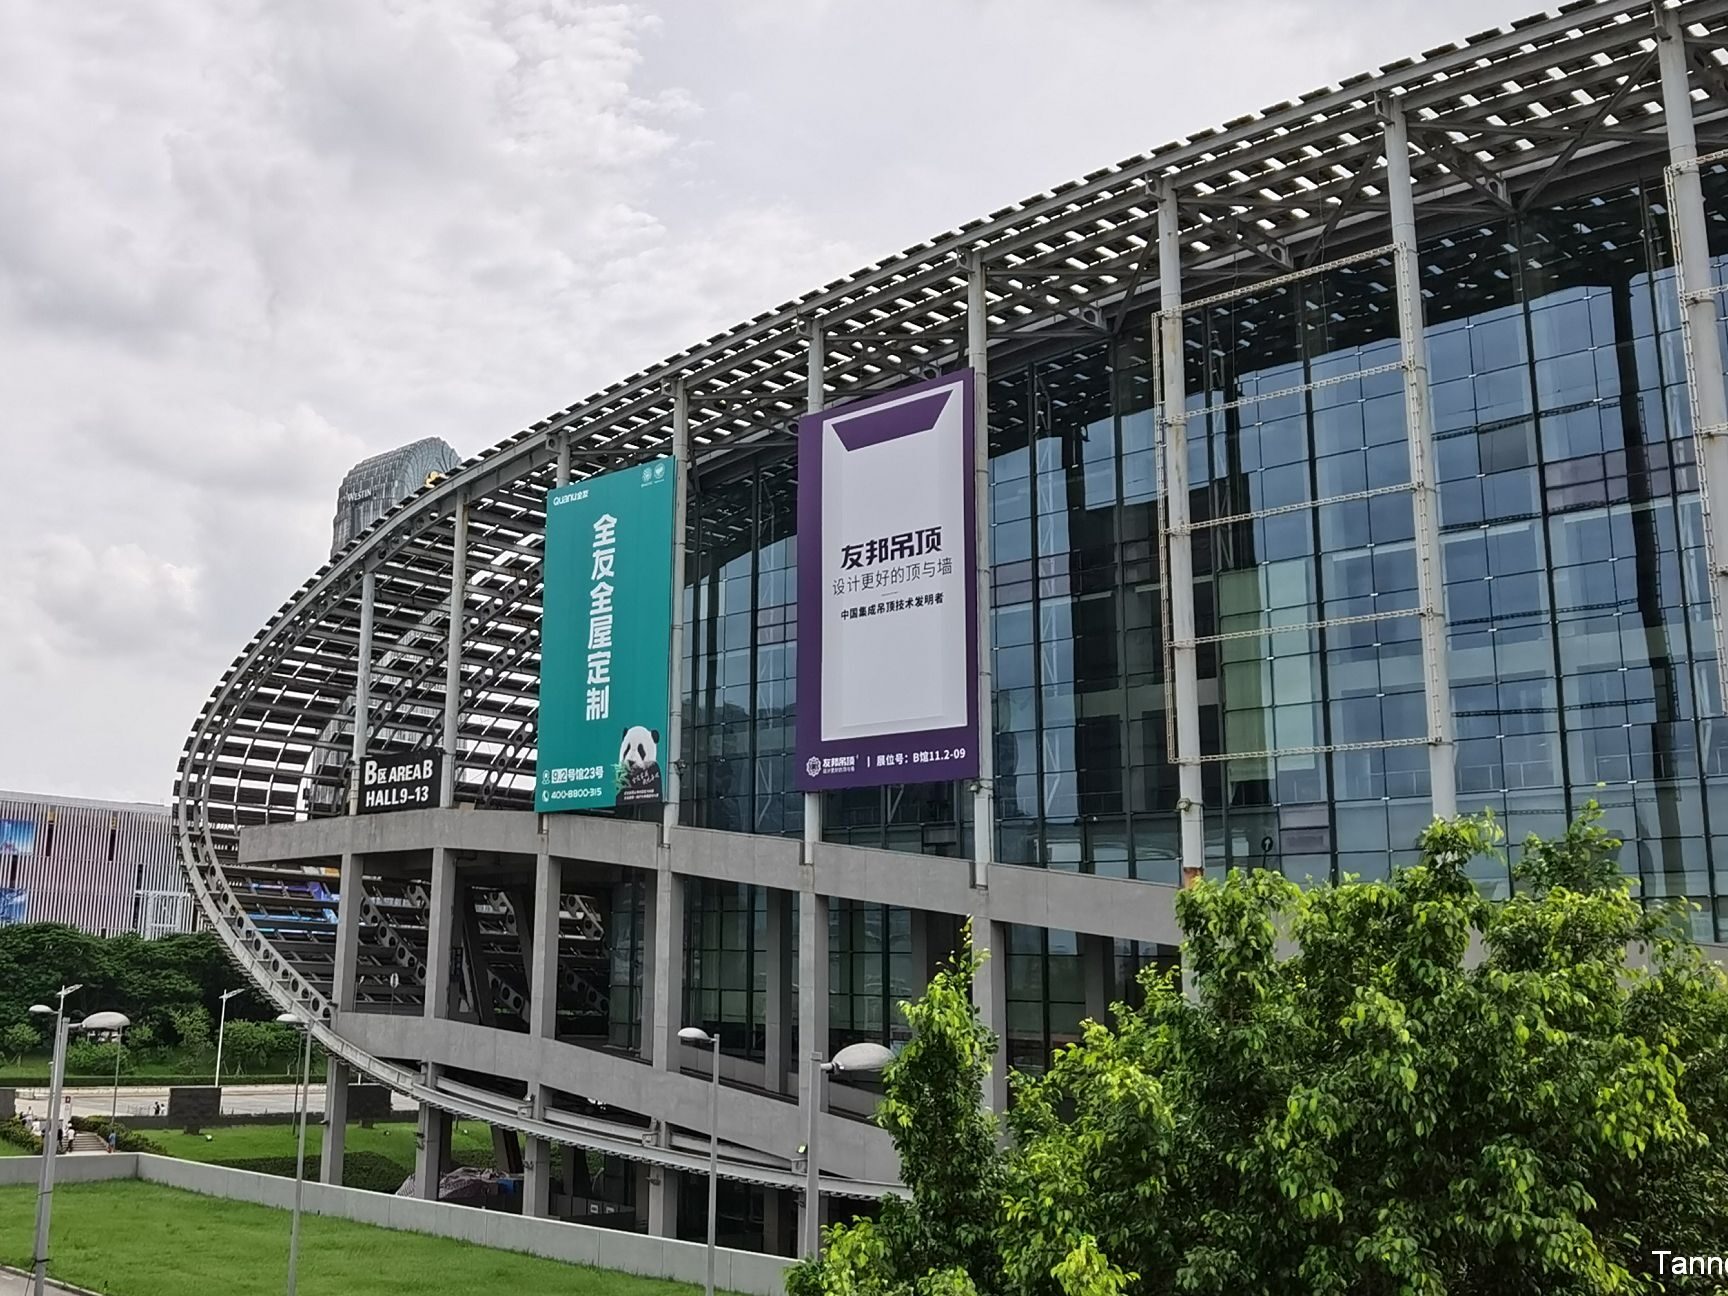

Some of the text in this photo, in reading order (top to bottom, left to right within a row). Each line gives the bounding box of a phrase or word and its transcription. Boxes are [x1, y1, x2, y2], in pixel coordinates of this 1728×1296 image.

[840, 526, 942, 570] 友邦吊顶
[832, 557, 952, 596] 设计更好的顶与墙
[586, 513, 617, 721] 全友全屋定制
[840, 592, 944, 620] 中国集成吊顶技术发明者
[365, 786, 429, 807] HALL 9-13
